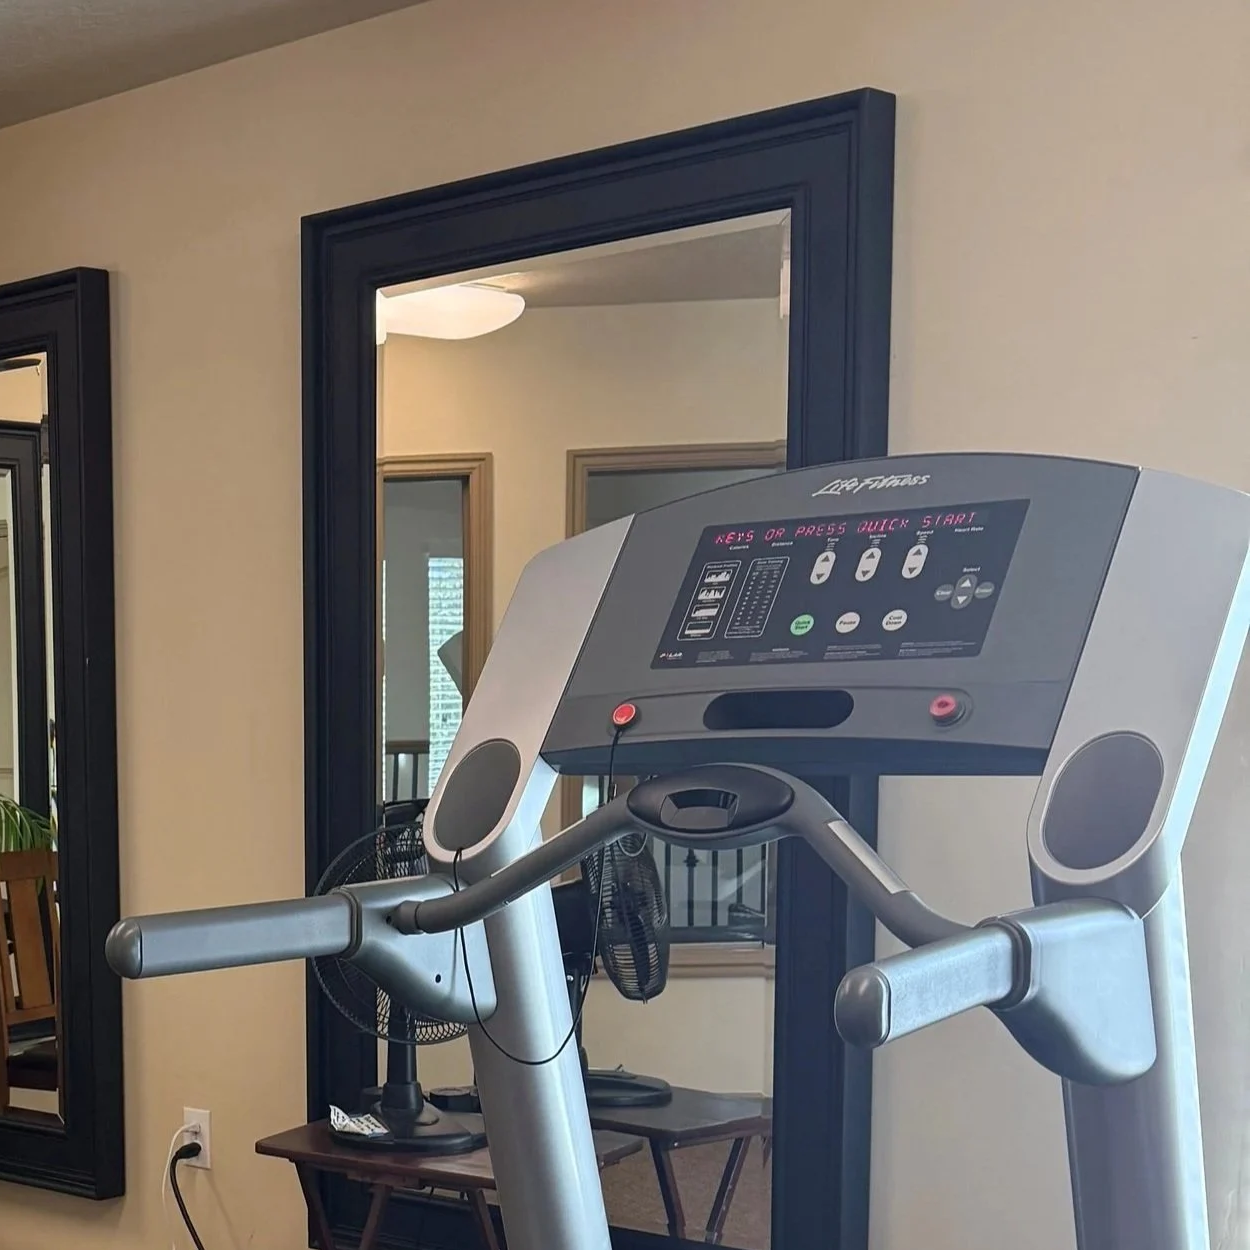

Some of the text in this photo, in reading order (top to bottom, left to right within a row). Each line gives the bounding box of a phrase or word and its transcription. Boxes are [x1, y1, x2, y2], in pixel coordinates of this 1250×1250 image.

[715, 512, 977, 544] KEYS OR PRESS QUICK START
